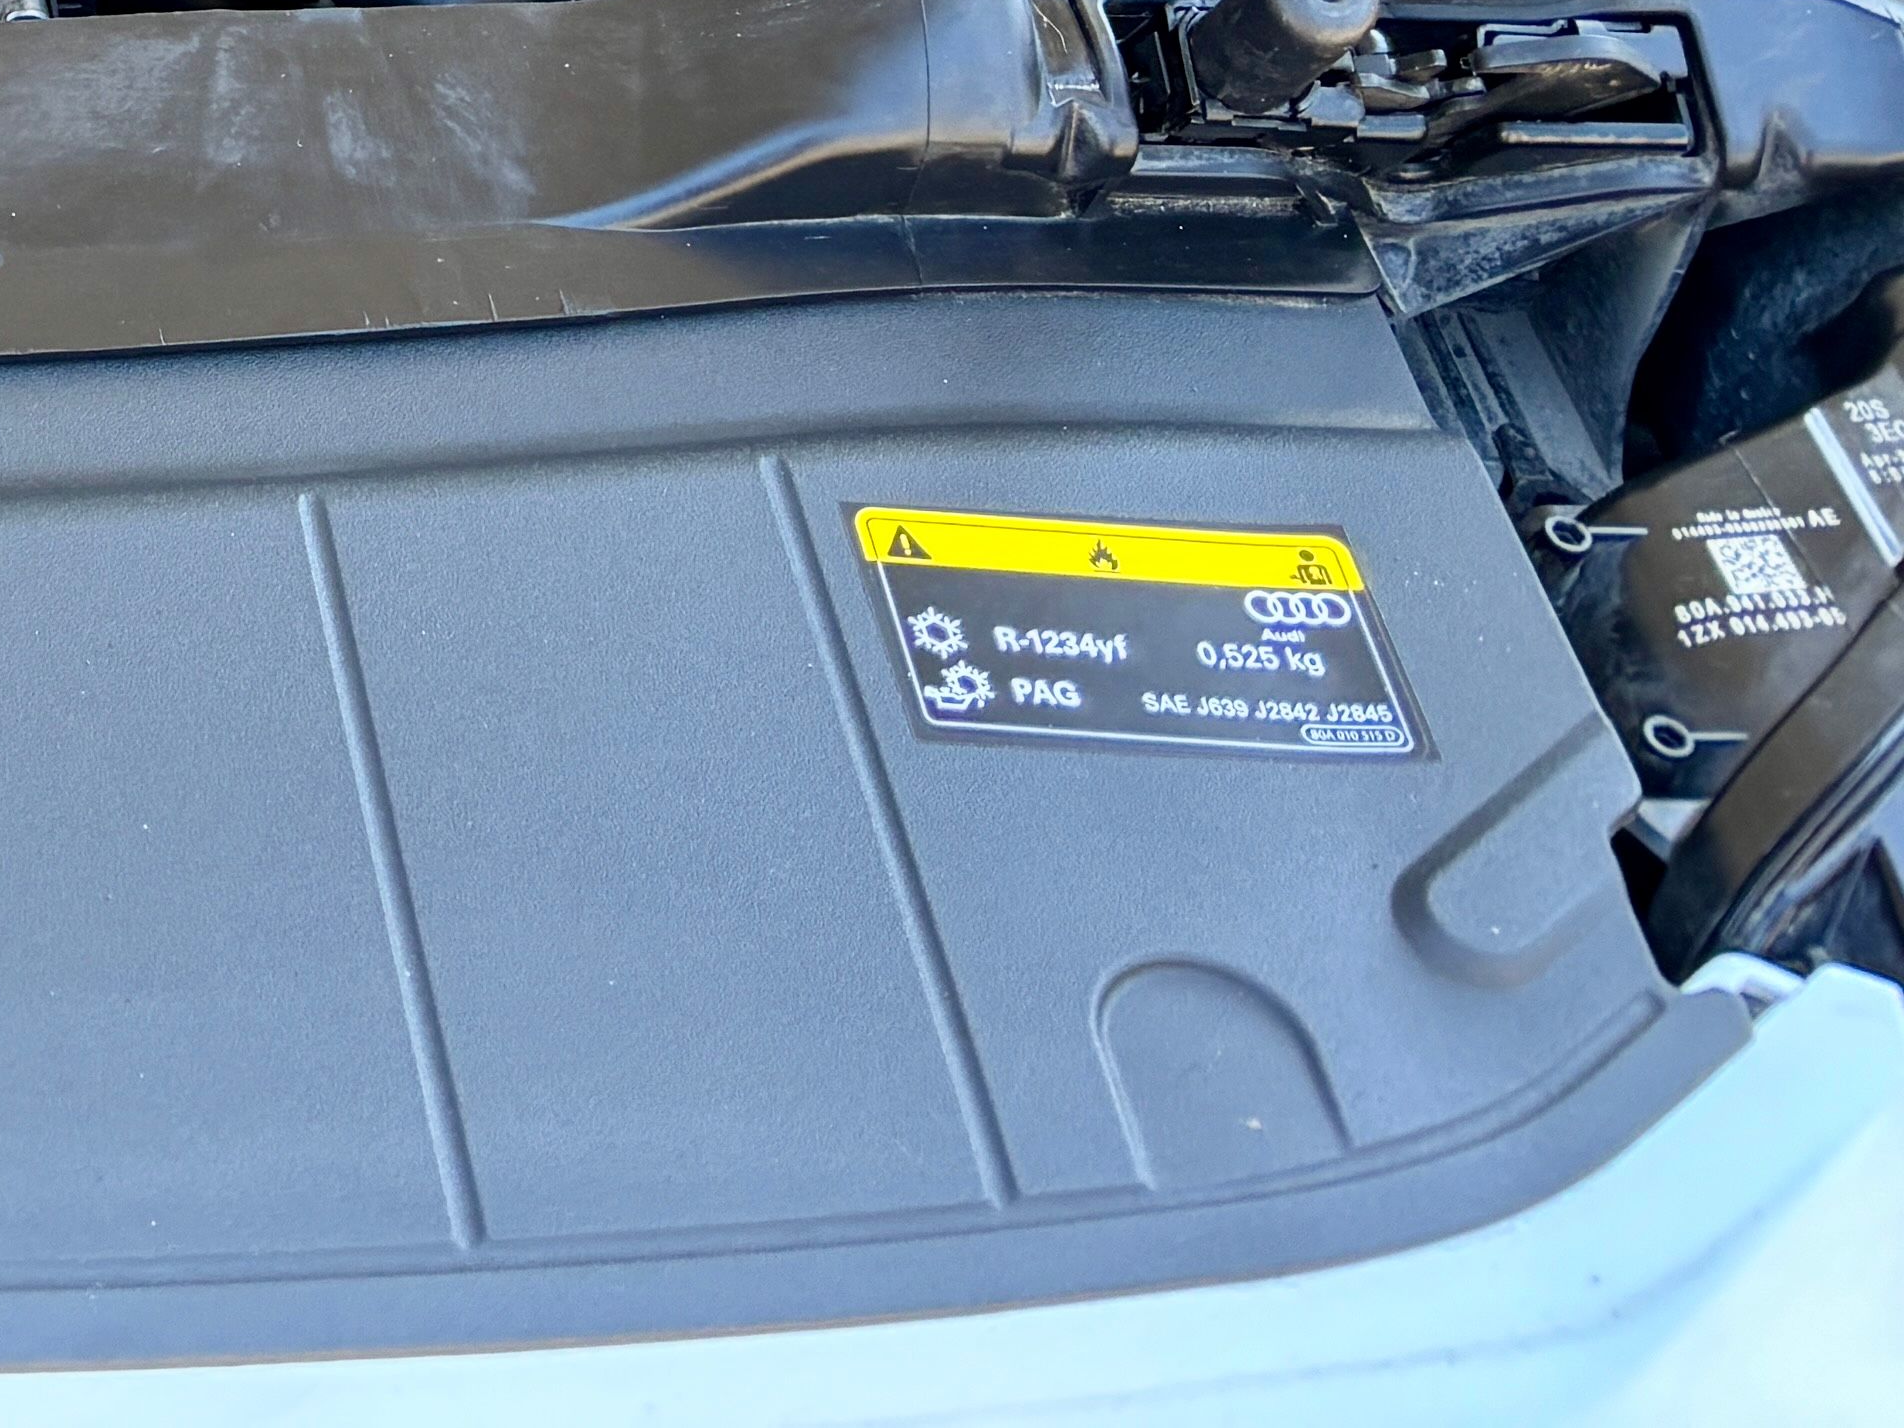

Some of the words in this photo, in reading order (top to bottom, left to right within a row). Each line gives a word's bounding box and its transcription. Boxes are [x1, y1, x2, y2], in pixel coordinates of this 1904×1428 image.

[1807, 507, 1841, 528] AE
[992, 625, 1130, 664] R-1234yf
[1196, 641, 1281, 671] 0,525
[1288, 646, 1326, 679] kg
[1260, 628, 1306, 643] Audi
[1010, 677, 1083, 708] PAG
[1141, 691, 1192, 715] SAE
[1196, 697, 1250, 719] J639
[1254, 700, 1321, 722] J2842
[1326, 703, 1393, 723] J2845
